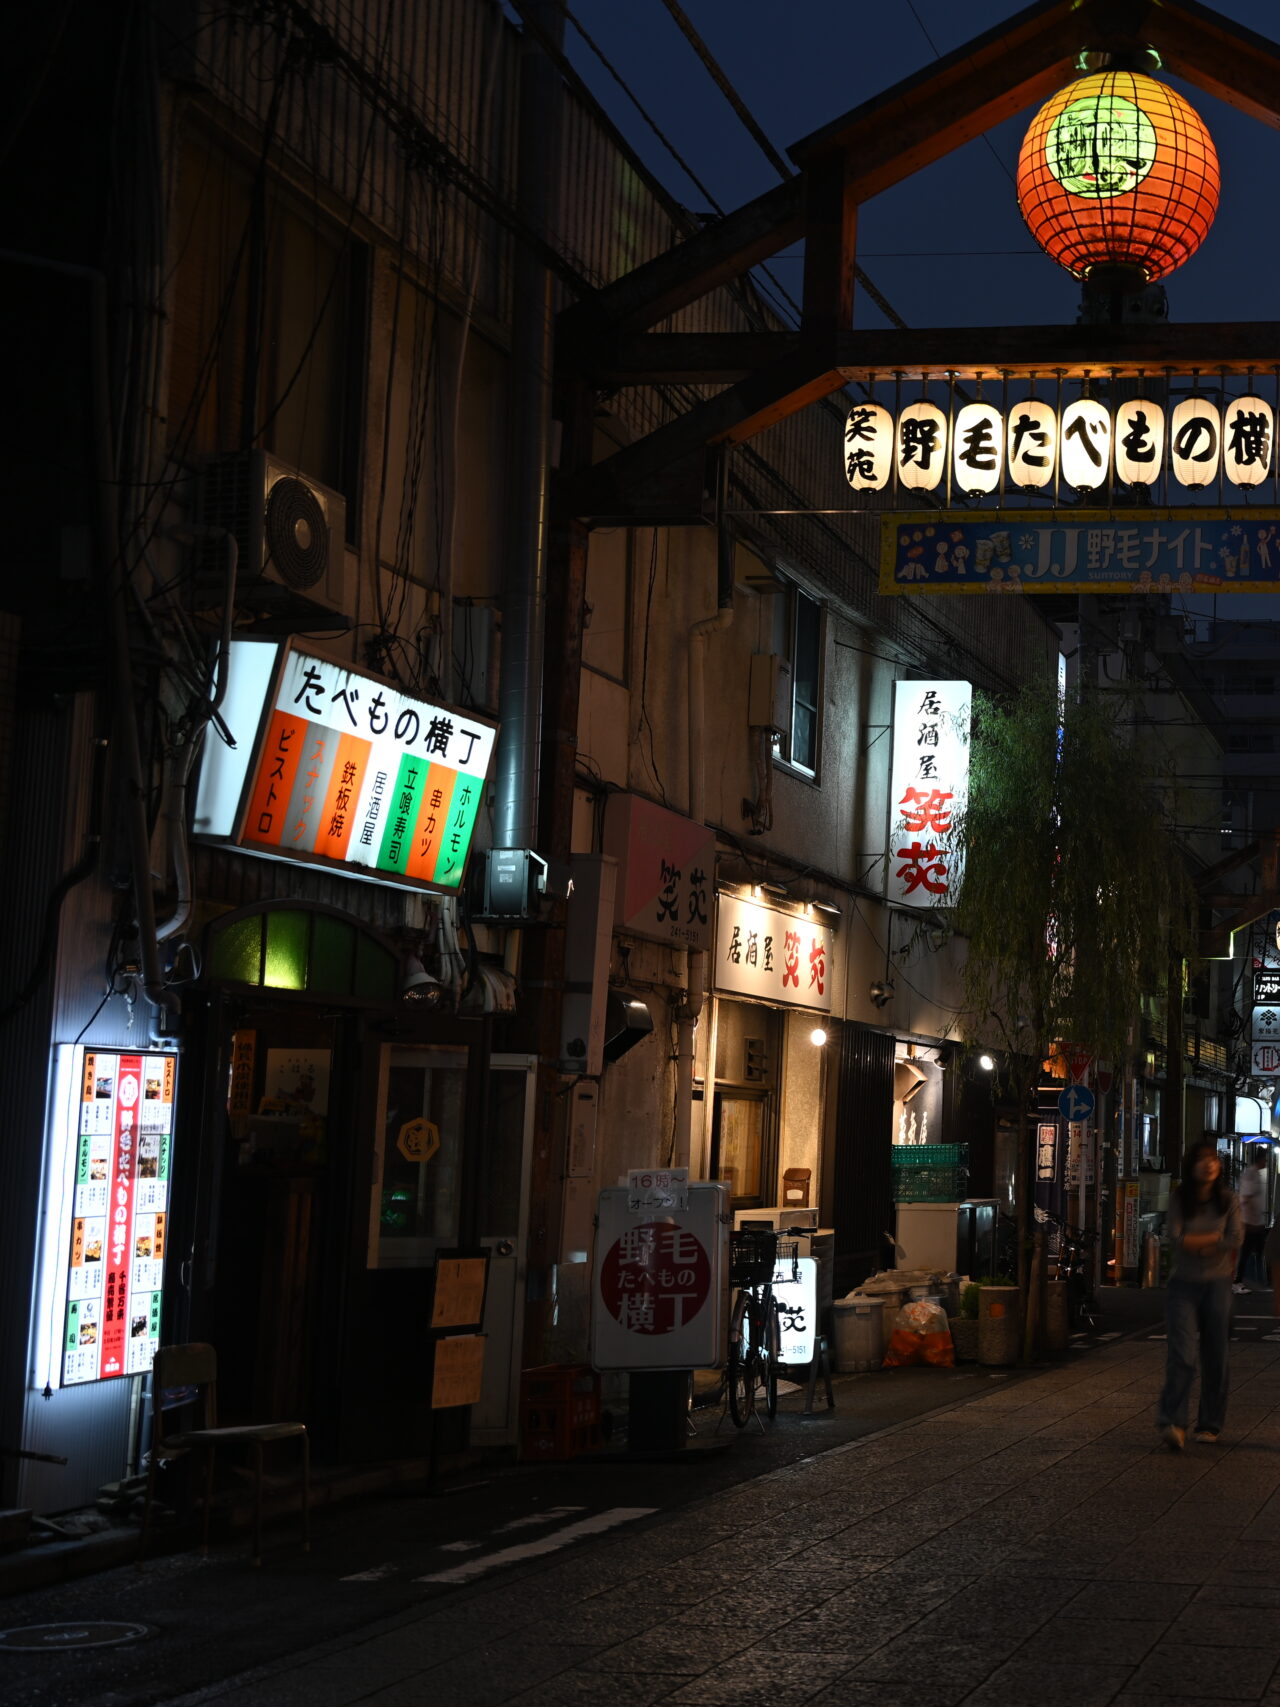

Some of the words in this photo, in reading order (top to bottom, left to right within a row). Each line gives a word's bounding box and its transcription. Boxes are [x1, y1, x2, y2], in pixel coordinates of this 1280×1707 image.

[845, 408, 877, 482] 笑苑
[1087, 527, 1213, 570] 野毛ナイト
[1088, 572, 1134, 580] SUNTORY
[294, 665, 481, 765] たべもの横丁
[916, 690, 942, 780] 居酒屋
[257, 728, 295, 833] ビストロ
[293, 740, 325, 842] スナック
[328, 761, 357, 838] 鉄板焼
[360, 771, 387, 845] 居酒屋
[389, 768, 418, 864] 立喰寿司
[421, 789, 443, 856] 串カツ
[444, 786, 471, 875] ホルモン
[895, 786, 953, 895] 笑苑
[656, 858, 708, 925] 笑苑
[670, 925, 699, 944] 241-5151
[727, 926, 773, 972] 居酒屋
[782, 930, 826, 996] 笑苑
[164, 1060, 172, 1096] ビストロ
[618, 1228, 699, 1266] 野毛
[616, 1292, 699, 1332] 横丁
